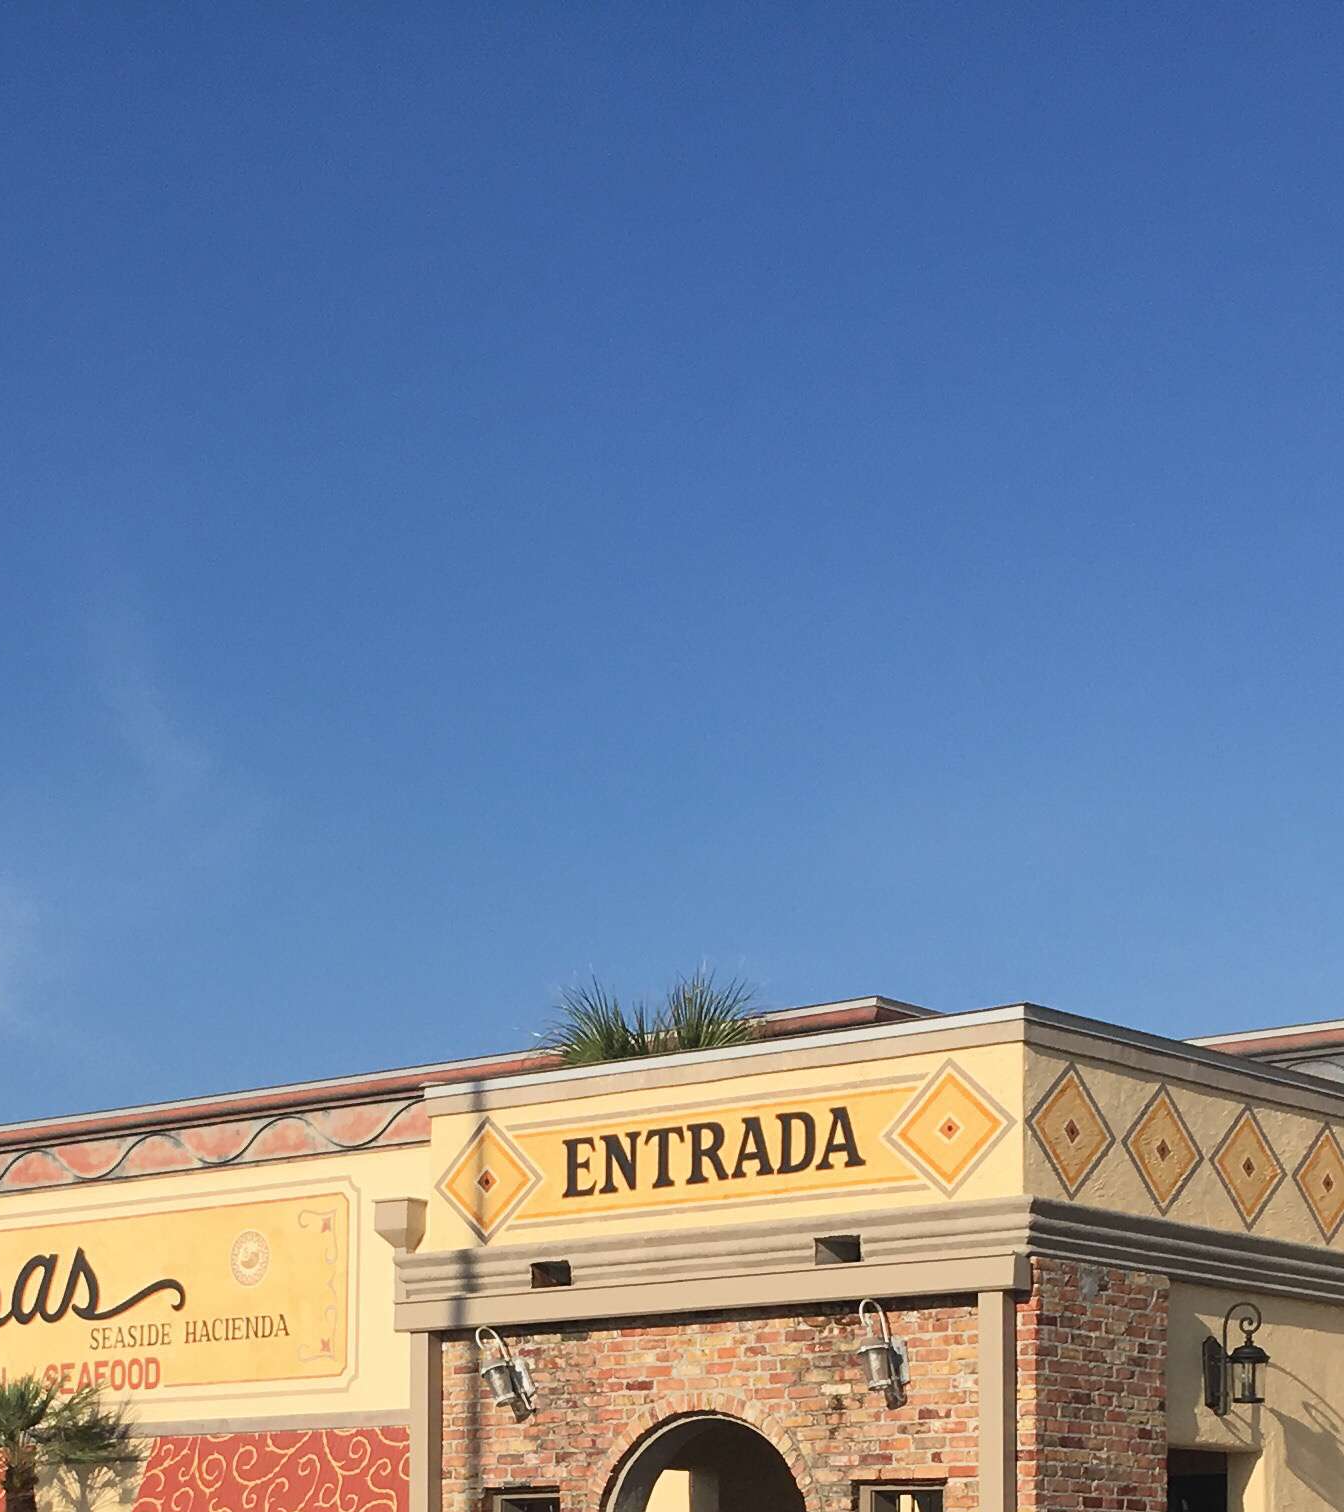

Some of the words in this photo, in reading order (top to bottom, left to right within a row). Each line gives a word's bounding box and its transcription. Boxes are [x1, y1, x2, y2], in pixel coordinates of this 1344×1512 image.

[562, 1105, 866, 1199] ENTRADA
[89, 1322, 173, 1351] SEASIDE
[183, 1313, 291, 1345] HACIENDA
[44, 1356, 162, 1396] SEAFOOD
